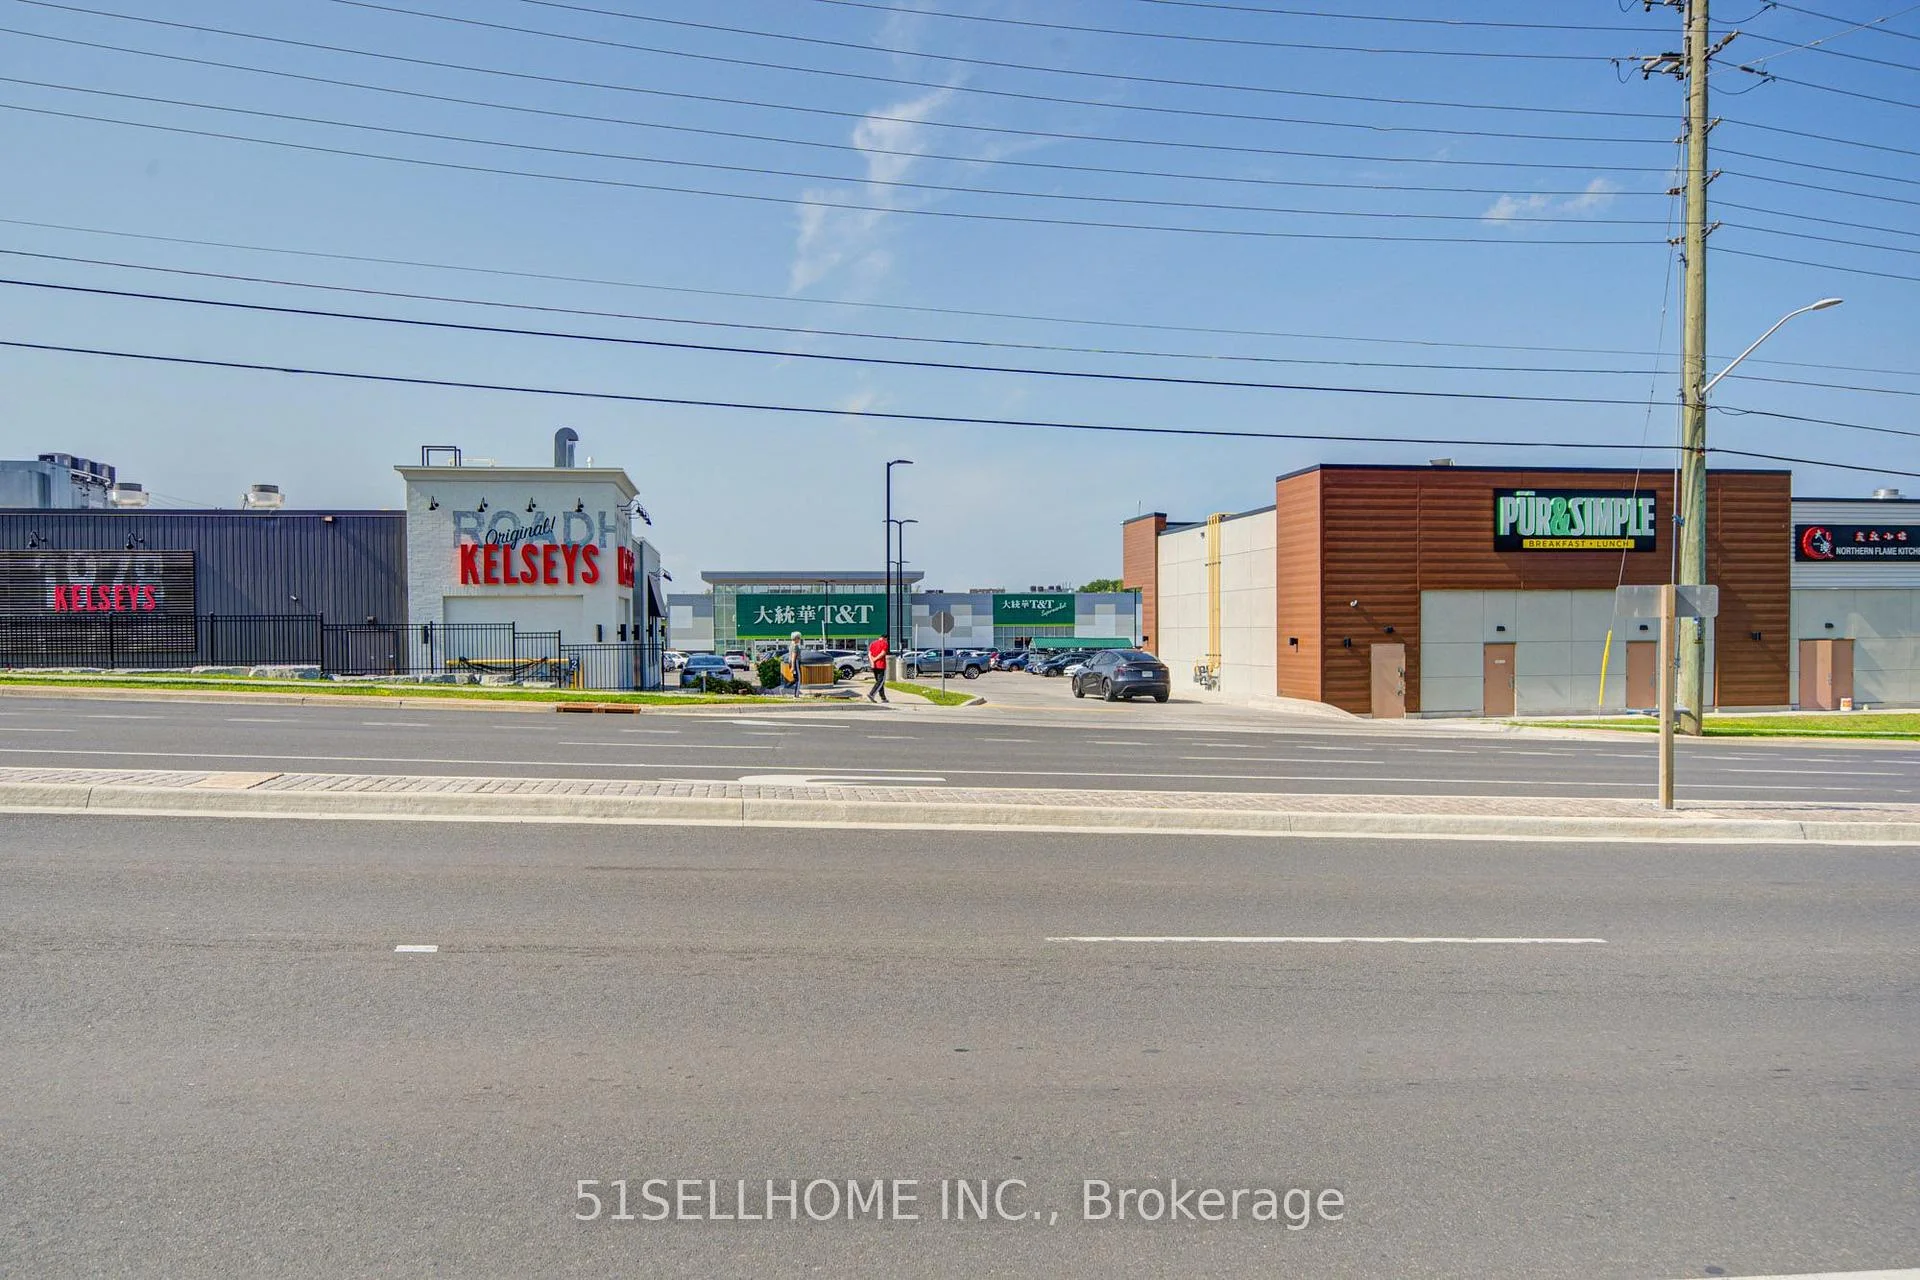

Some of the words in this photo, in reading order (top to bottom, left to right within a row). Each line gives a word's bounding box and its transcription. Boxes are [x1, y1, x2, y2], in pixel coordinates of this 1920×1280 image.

[485, 516, 556, 551] Original!
[1528, 540, 1585, 548] BREAKFAST
[1596, 540, 1629, 548] LUNCH
[1835, 546, 1874, 556] NORTHERN
[1874, 546, 1898, 556] FLAME
[460, 544, 600, 585] KELSEYS
[53, 585, 157, 613] KELSEYS
[1029, 600, 1055, 609] T&T
[817, 604, 874, 625] T&T
